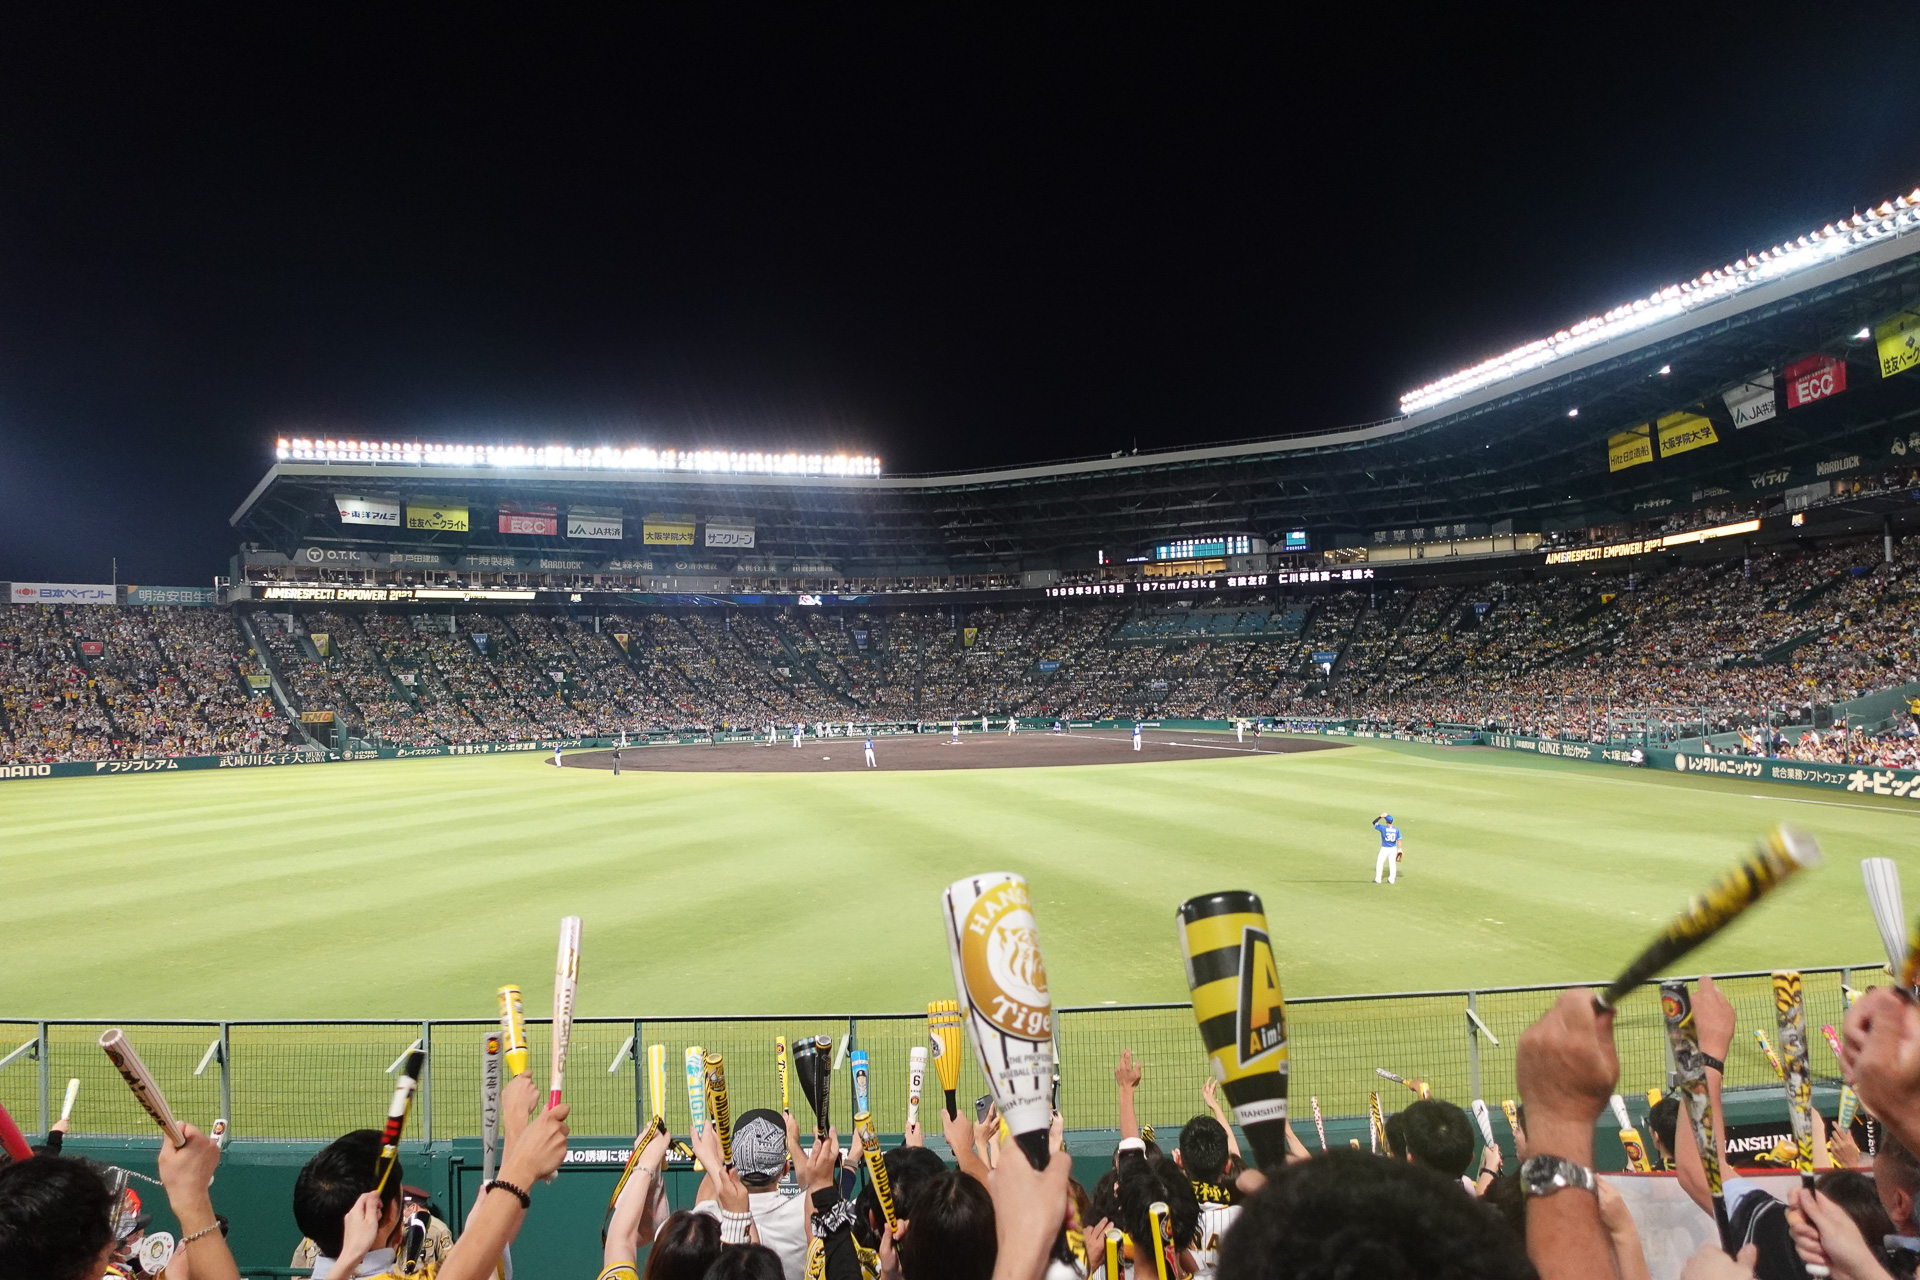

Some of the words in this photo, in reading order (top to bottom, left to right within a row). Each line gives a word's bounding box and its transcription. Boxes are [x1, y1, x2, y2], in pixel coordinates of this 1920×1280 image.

[1797, 374, 1834, 404] ECC
[1661, 426, 1712, 451] 大阪学院大学
[351, 510, 397, 521] 東洋アルミ
[409, 517, 467, 531] 住友ベークライト
[511, 520, 546, 534] ECC
[588, 527, 621, 537] JA共済
[645, 532, 694, 542] 大阪学院大学
[708, 533, 752, 545] サニクリーン
[327, 550, 360, 560] O.T.K.
[1603, 541, 1643, 558] EMPOWER!
[404, 554, 440, 564] 戸田建設
[465, 555, 515, 568] 千寿製薬
[540, 559, 582, 570] HARDLOCK
[39, 588, 112, 599] 日本ペイント
[337, 588, 387, 601] EMPOWER!
[1045, 583, 1125, 597] 1999年3月13日
[1136, 580, 1217, 592] 187cm/93kg
[138, 589, 217, 603] 明治安田生命
[404, 748, 442, 756] レイズネクスト
[455, 744, 490, 755] 東海大学
[1538, 740, 1560, 756] GUNZE
[219, 751, 304, 768] 武庫川女子大
[109, 760, 179, 773] フジプレアム
[1688, 756, 1762, 777] レンタルのニッケン
[1771, 766, 1846, 785] 統合業務ソフトウェア
[1385, 832, 1397, 842] 30
[1249, 1021, 1282, 1056] Aim!
[913, 1075, 921, 1087] 6
